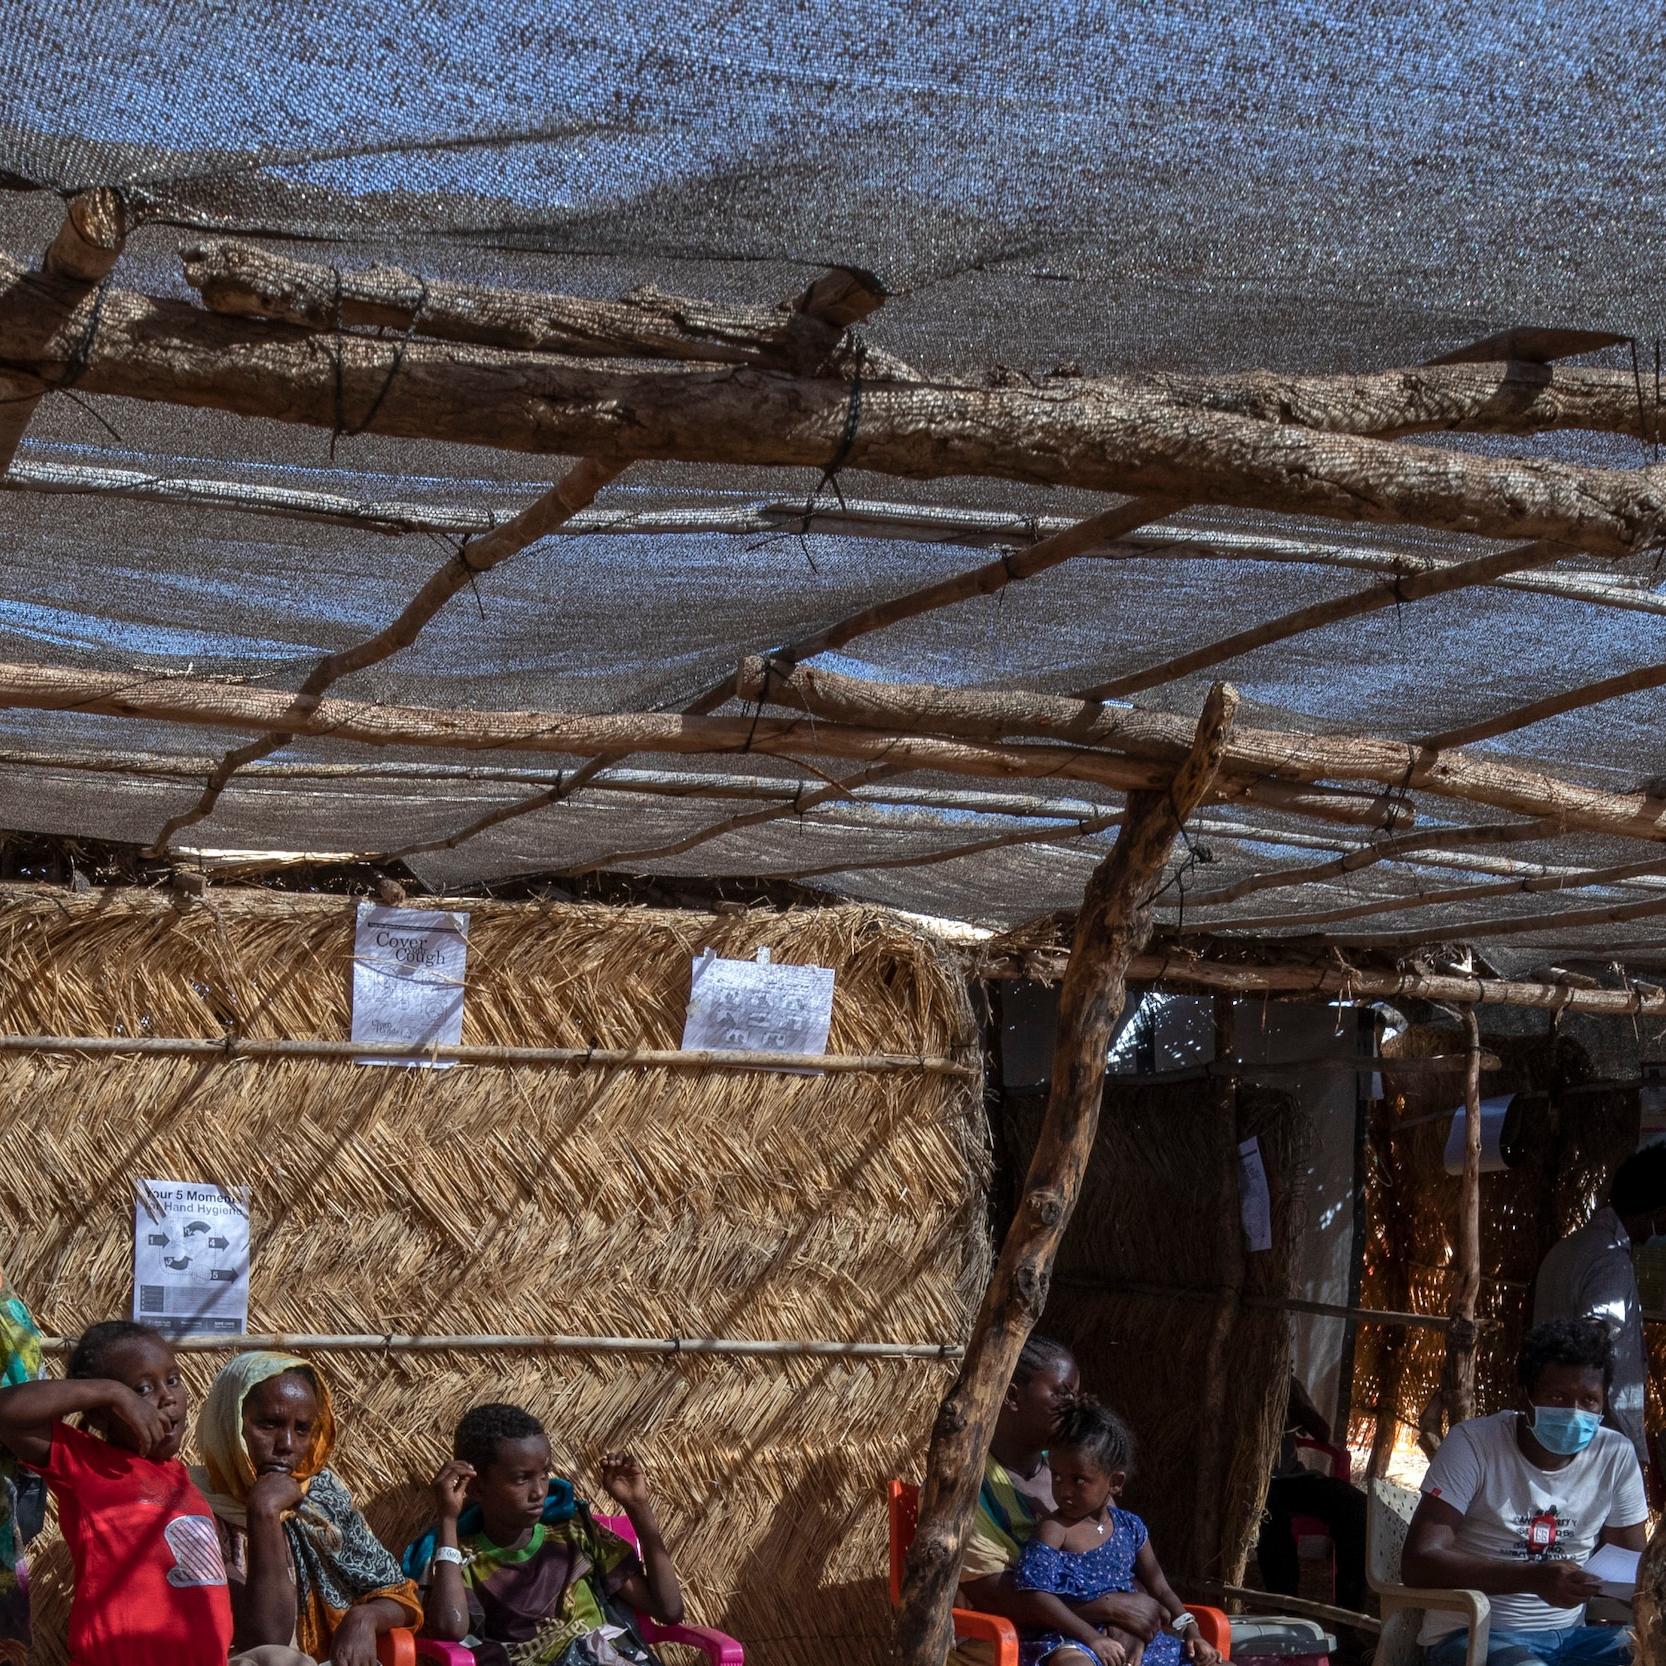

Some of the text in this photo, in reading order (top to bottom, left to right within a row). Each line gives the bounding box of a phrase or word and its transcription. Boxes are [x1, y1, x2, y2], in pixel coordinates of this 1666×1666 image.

[376, 931, 428, 949] Cover
[395, 947, 446, 967] Cough
[176, 1190, 183, 1200] 5
[164, 1201, 193, 1213] Hand
[149, 1236, 154, 1245] 1
[209, 1239, 216, 1247] 4
[212, 1271, 219, 1279] 5
